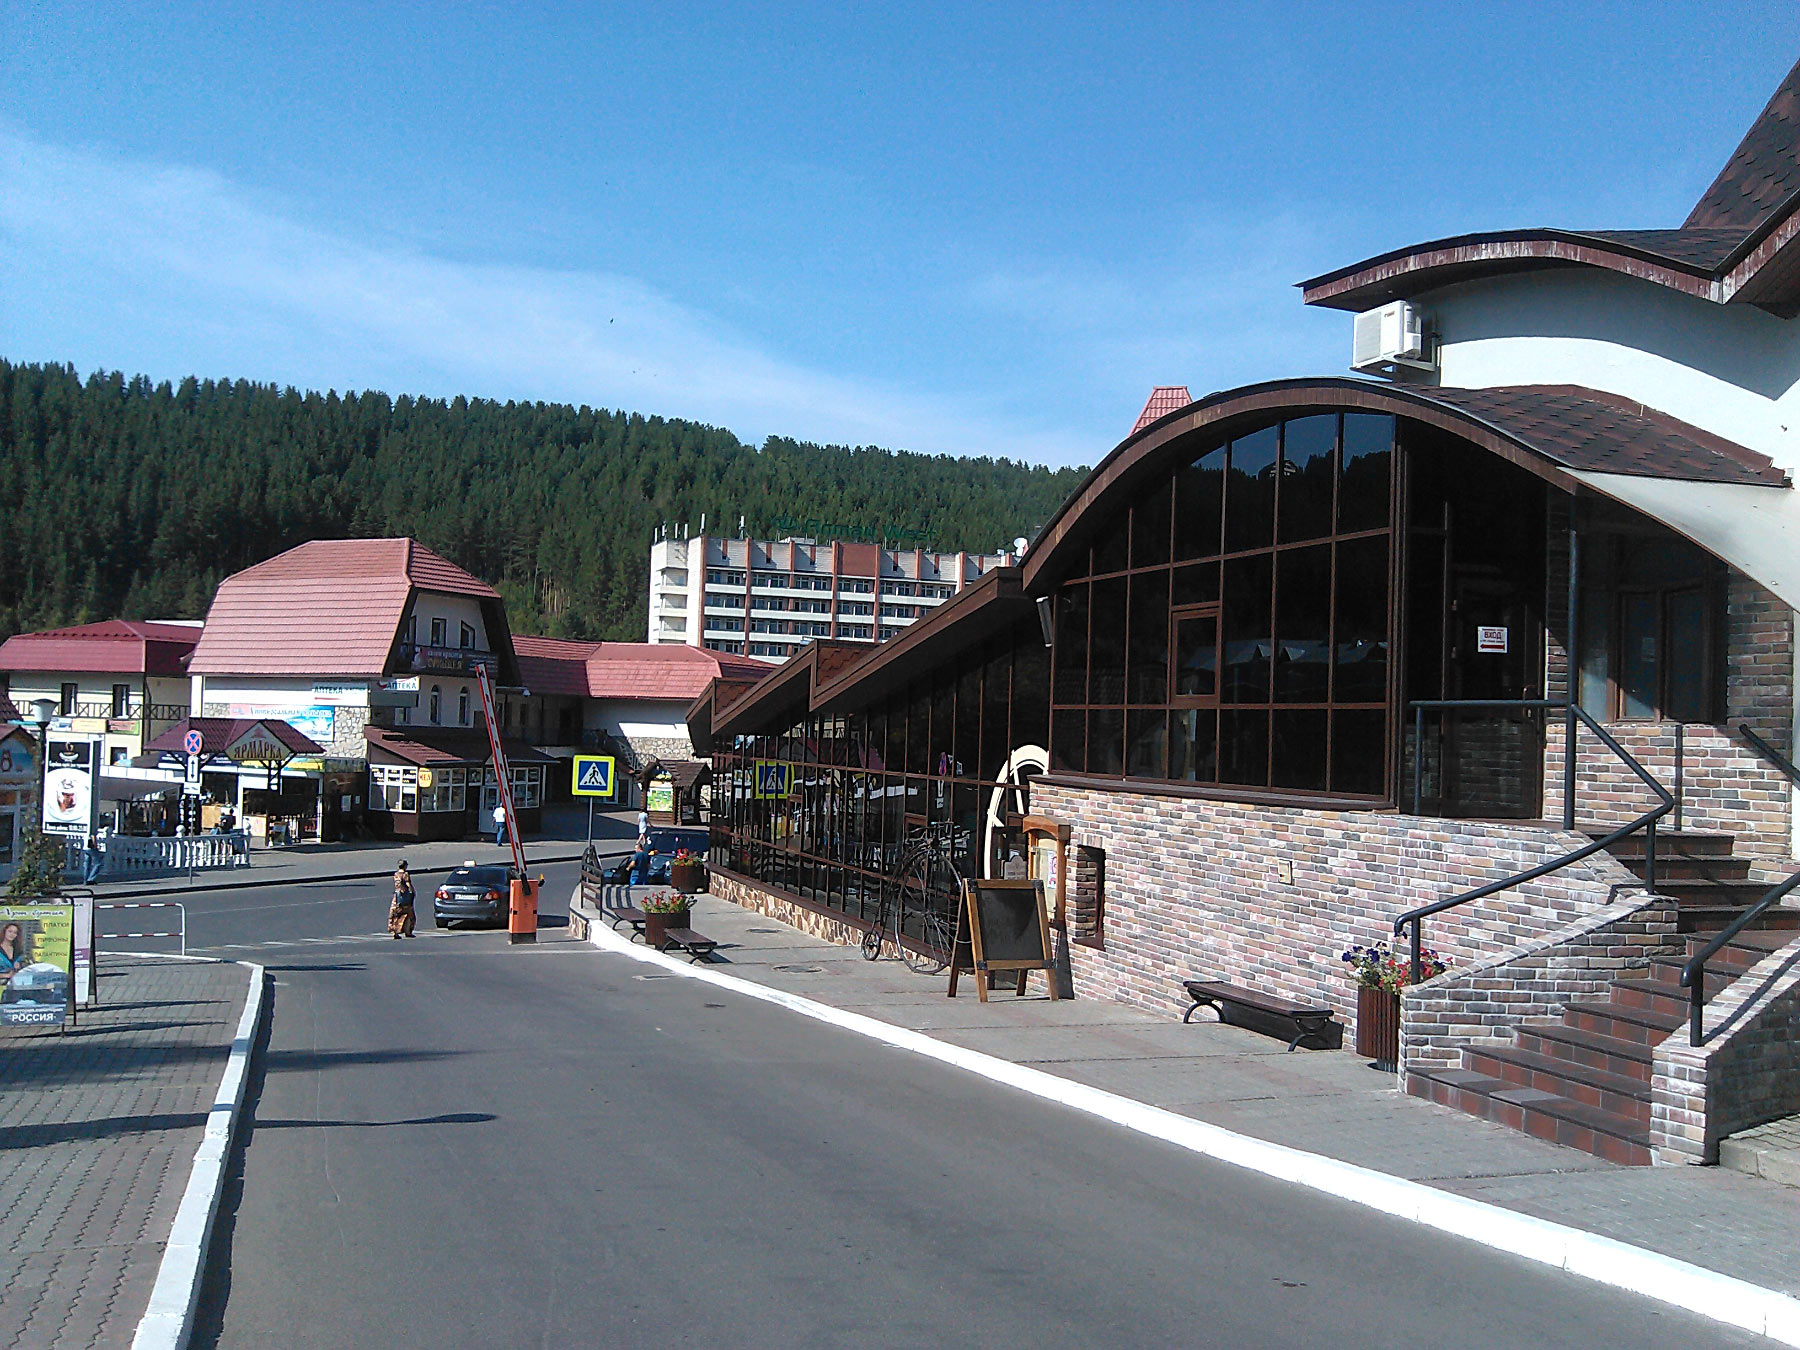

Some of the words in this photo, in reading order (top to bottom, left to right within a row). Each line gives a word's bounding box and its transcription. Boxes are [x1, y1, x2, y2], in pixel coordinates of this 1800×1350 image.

[313, 685, 343, 695] АПТЕКА
[387, 681, 417, 690] АПТЕКА
[233, 737, 282, 760] ЯРМАРКА
[12, 1013, 54, 1022] РОССИЯ
